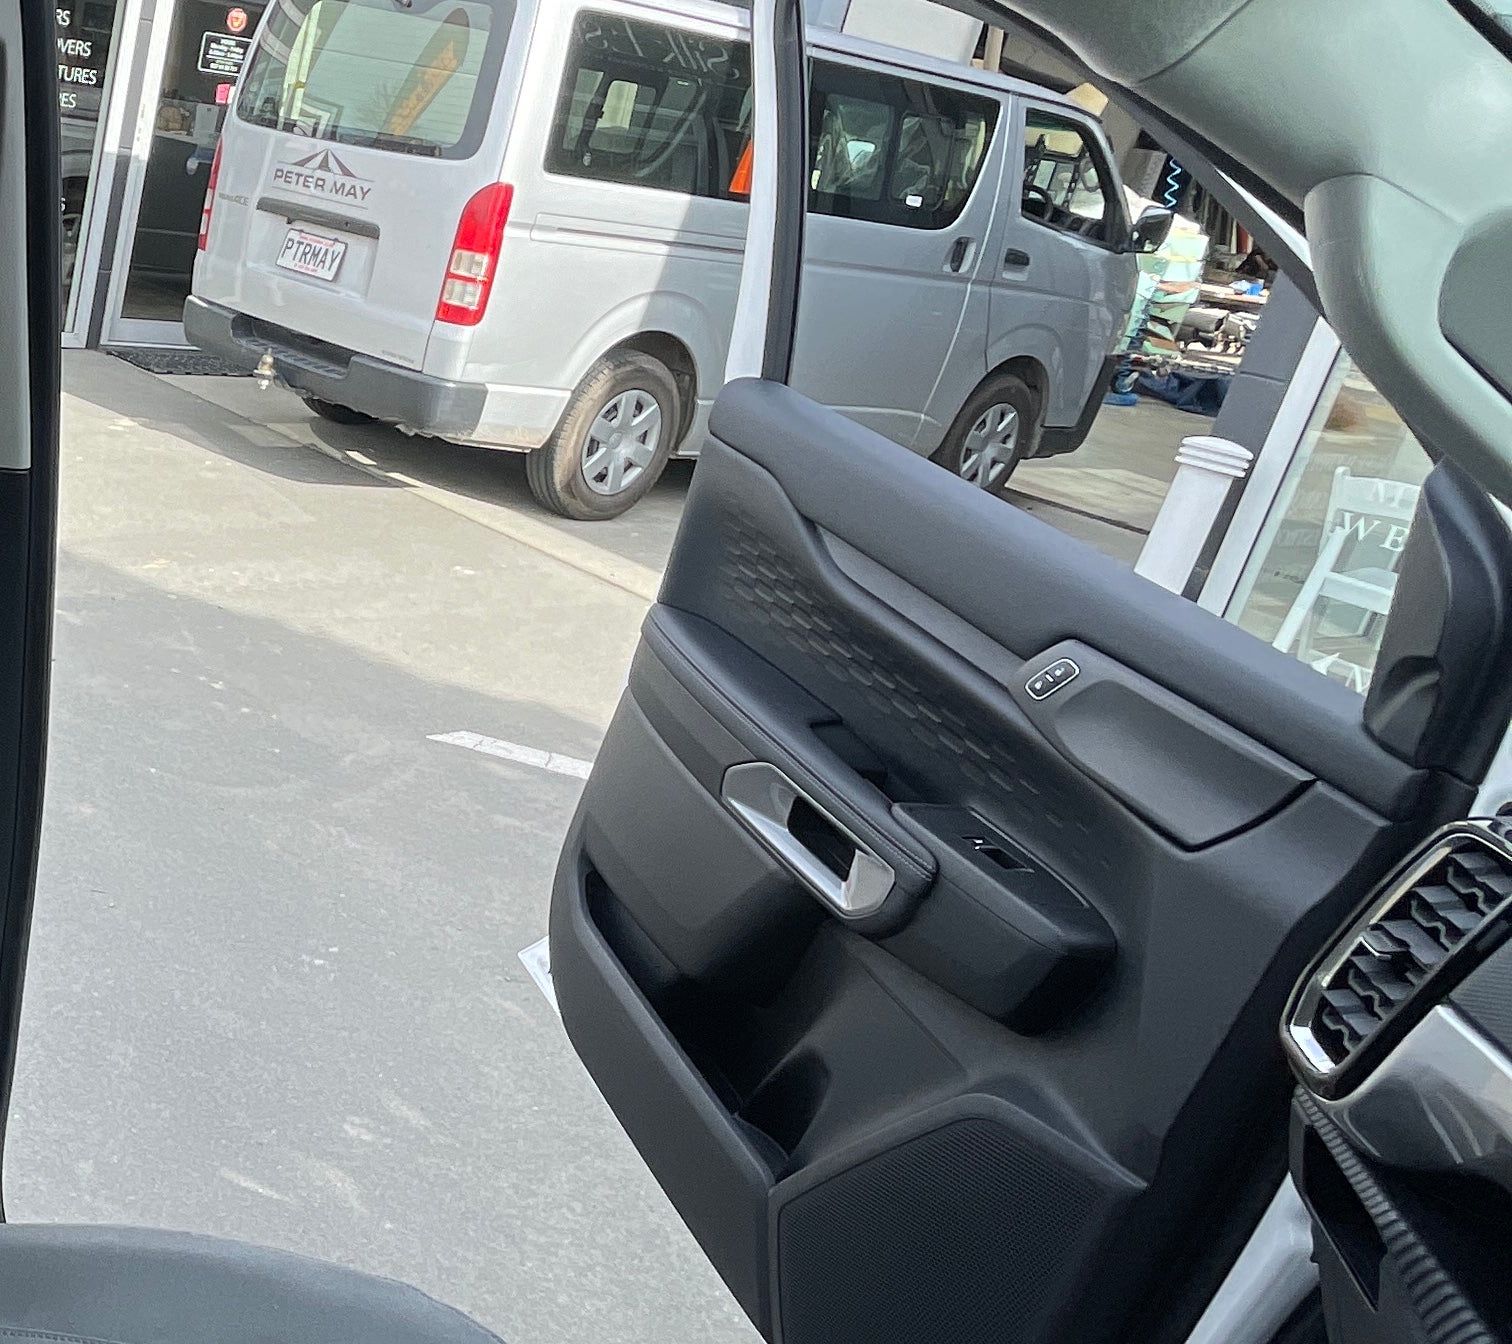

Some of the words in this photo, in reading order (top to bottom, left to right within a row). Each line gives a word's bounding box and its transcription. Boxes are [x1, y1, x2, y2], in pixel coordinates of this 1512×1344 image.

[273, 168, 326, 192] PETER
[330, 181, 372, 201] MAY
[281, 238, 341, 272] PTRMAY
